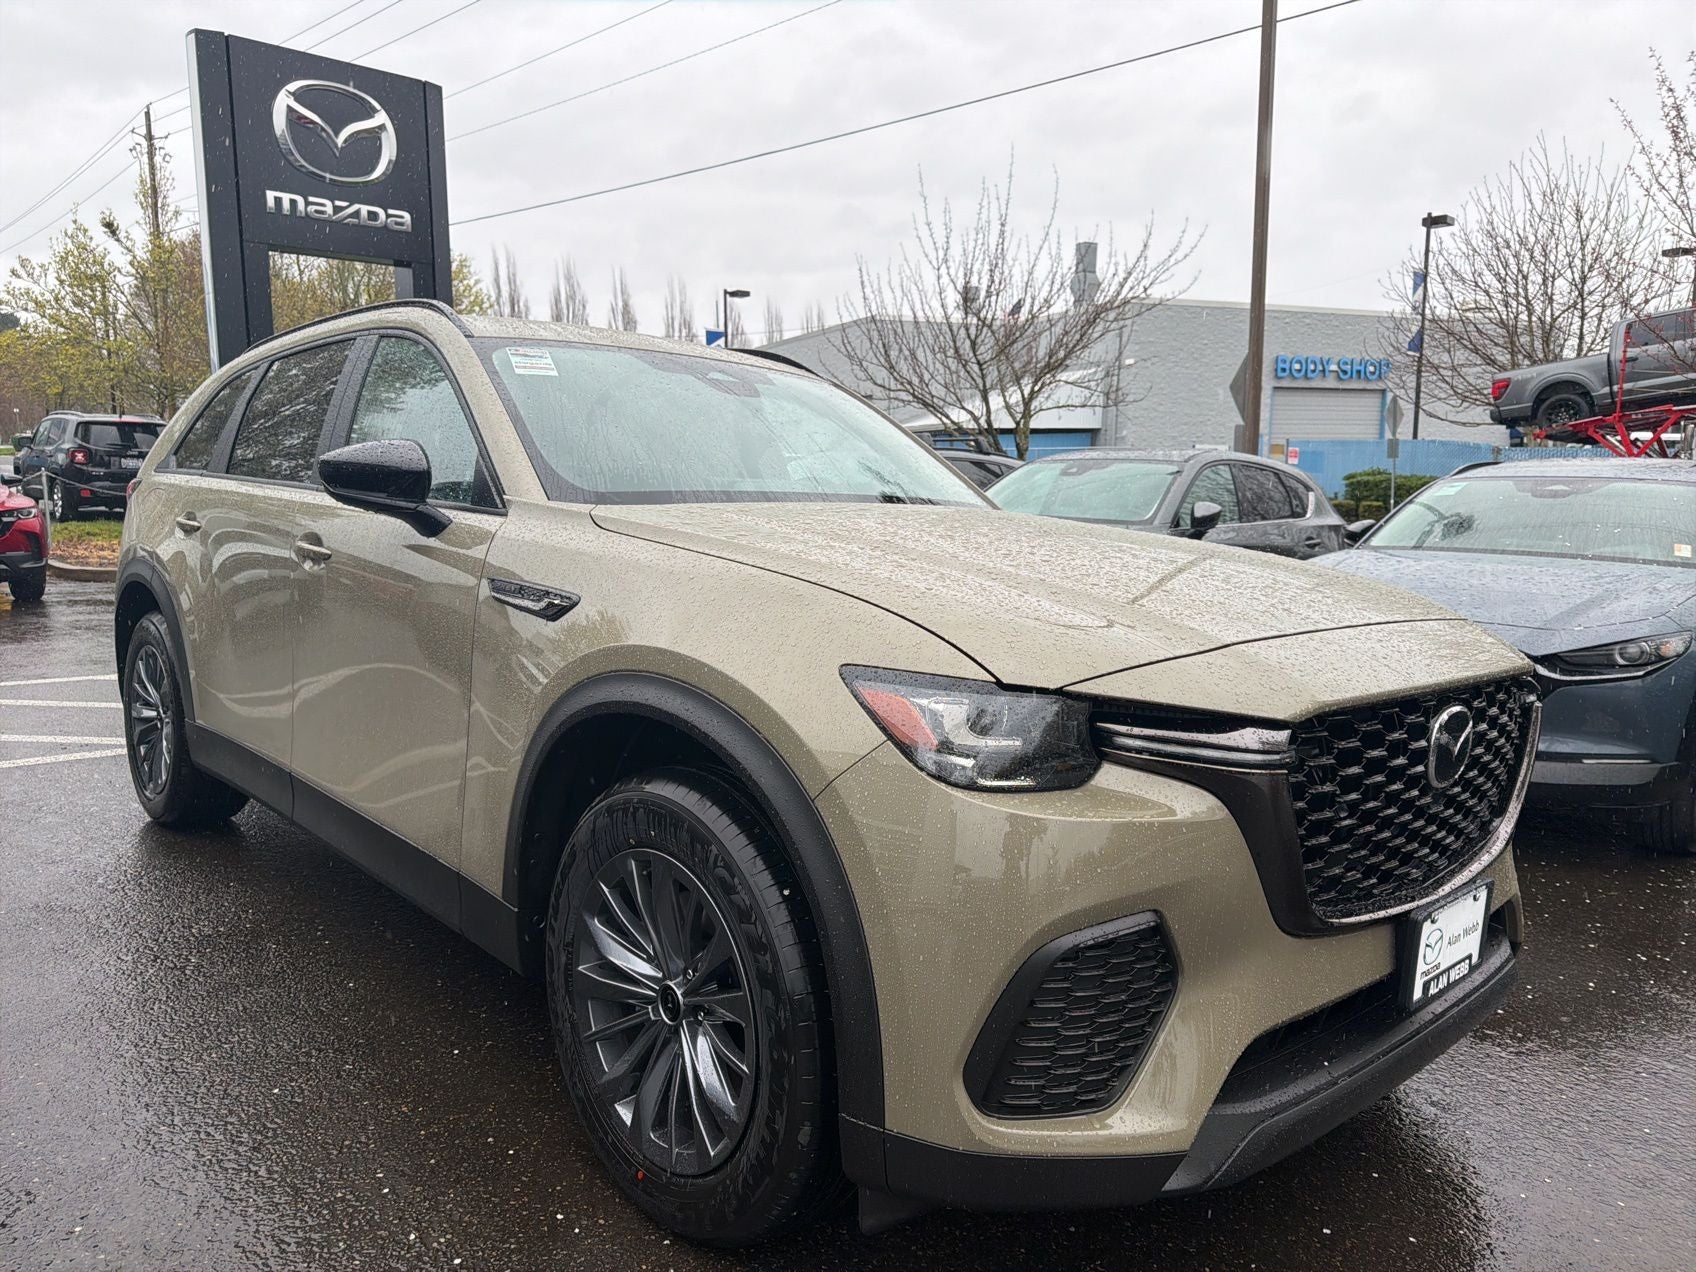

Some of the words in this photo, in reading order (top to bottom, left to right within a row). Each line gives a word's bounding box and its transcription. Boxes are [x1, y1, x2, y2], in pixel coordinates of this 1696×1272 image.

[265, 190, 412, 233] mazda
[1276, 354, 1332, 379] BODY
[1338, 356, 1392, 380] SHOP
[1447, 932, 1461, 947] Alan
[1463, 920, 1479, 939] Webb
[1429, 972, 1448, 996] ALAN
[1449, 959, 1470, 983] WEBB
